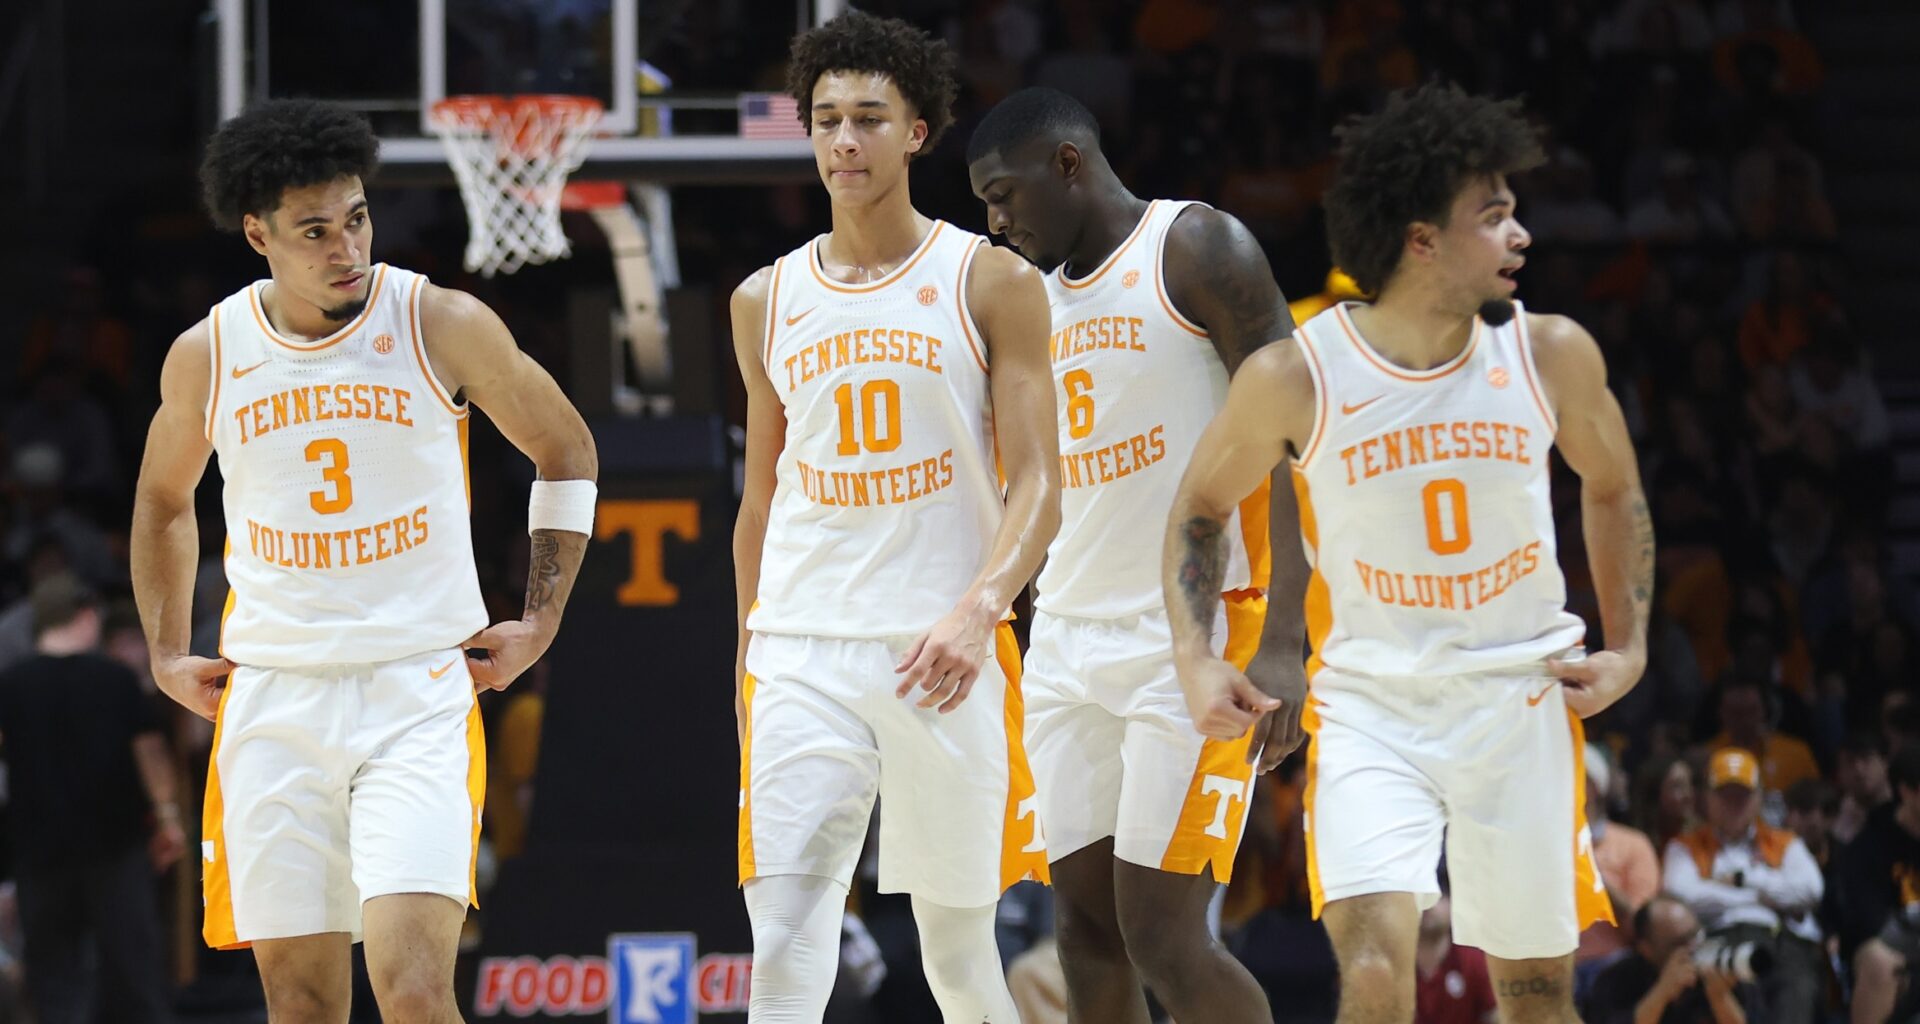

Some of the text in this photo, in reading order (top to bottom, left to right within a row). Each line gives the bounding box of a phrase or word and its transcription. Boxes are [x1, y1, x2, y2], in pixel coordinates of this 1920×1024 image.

[918, 287, 937, 304] SEC
[374, 335, 393, 353] SEC
[785, 328, 942, 392] TENNESSEE
[234, 384, 414, 445] TENNESSEE
[834, 378, 902, 457] 10
[1063, 369, 1095, 440] 6
[304, 438, 353, 515] 3
[797, 448, 953, 507] VOLUNTEERS
[1340, 421, 1531, 486] TENNESSEE
[247, 505, 429, 569] VOLUNTEERS
[1421, 477, 1472, 556] 0
[597, 501, 700, 606] T
[1354, 540, 1542, 611] VOLUNTEERS
[1201, 774, 1245, 840] T
[478, 958, 613, 1013] FOOD
